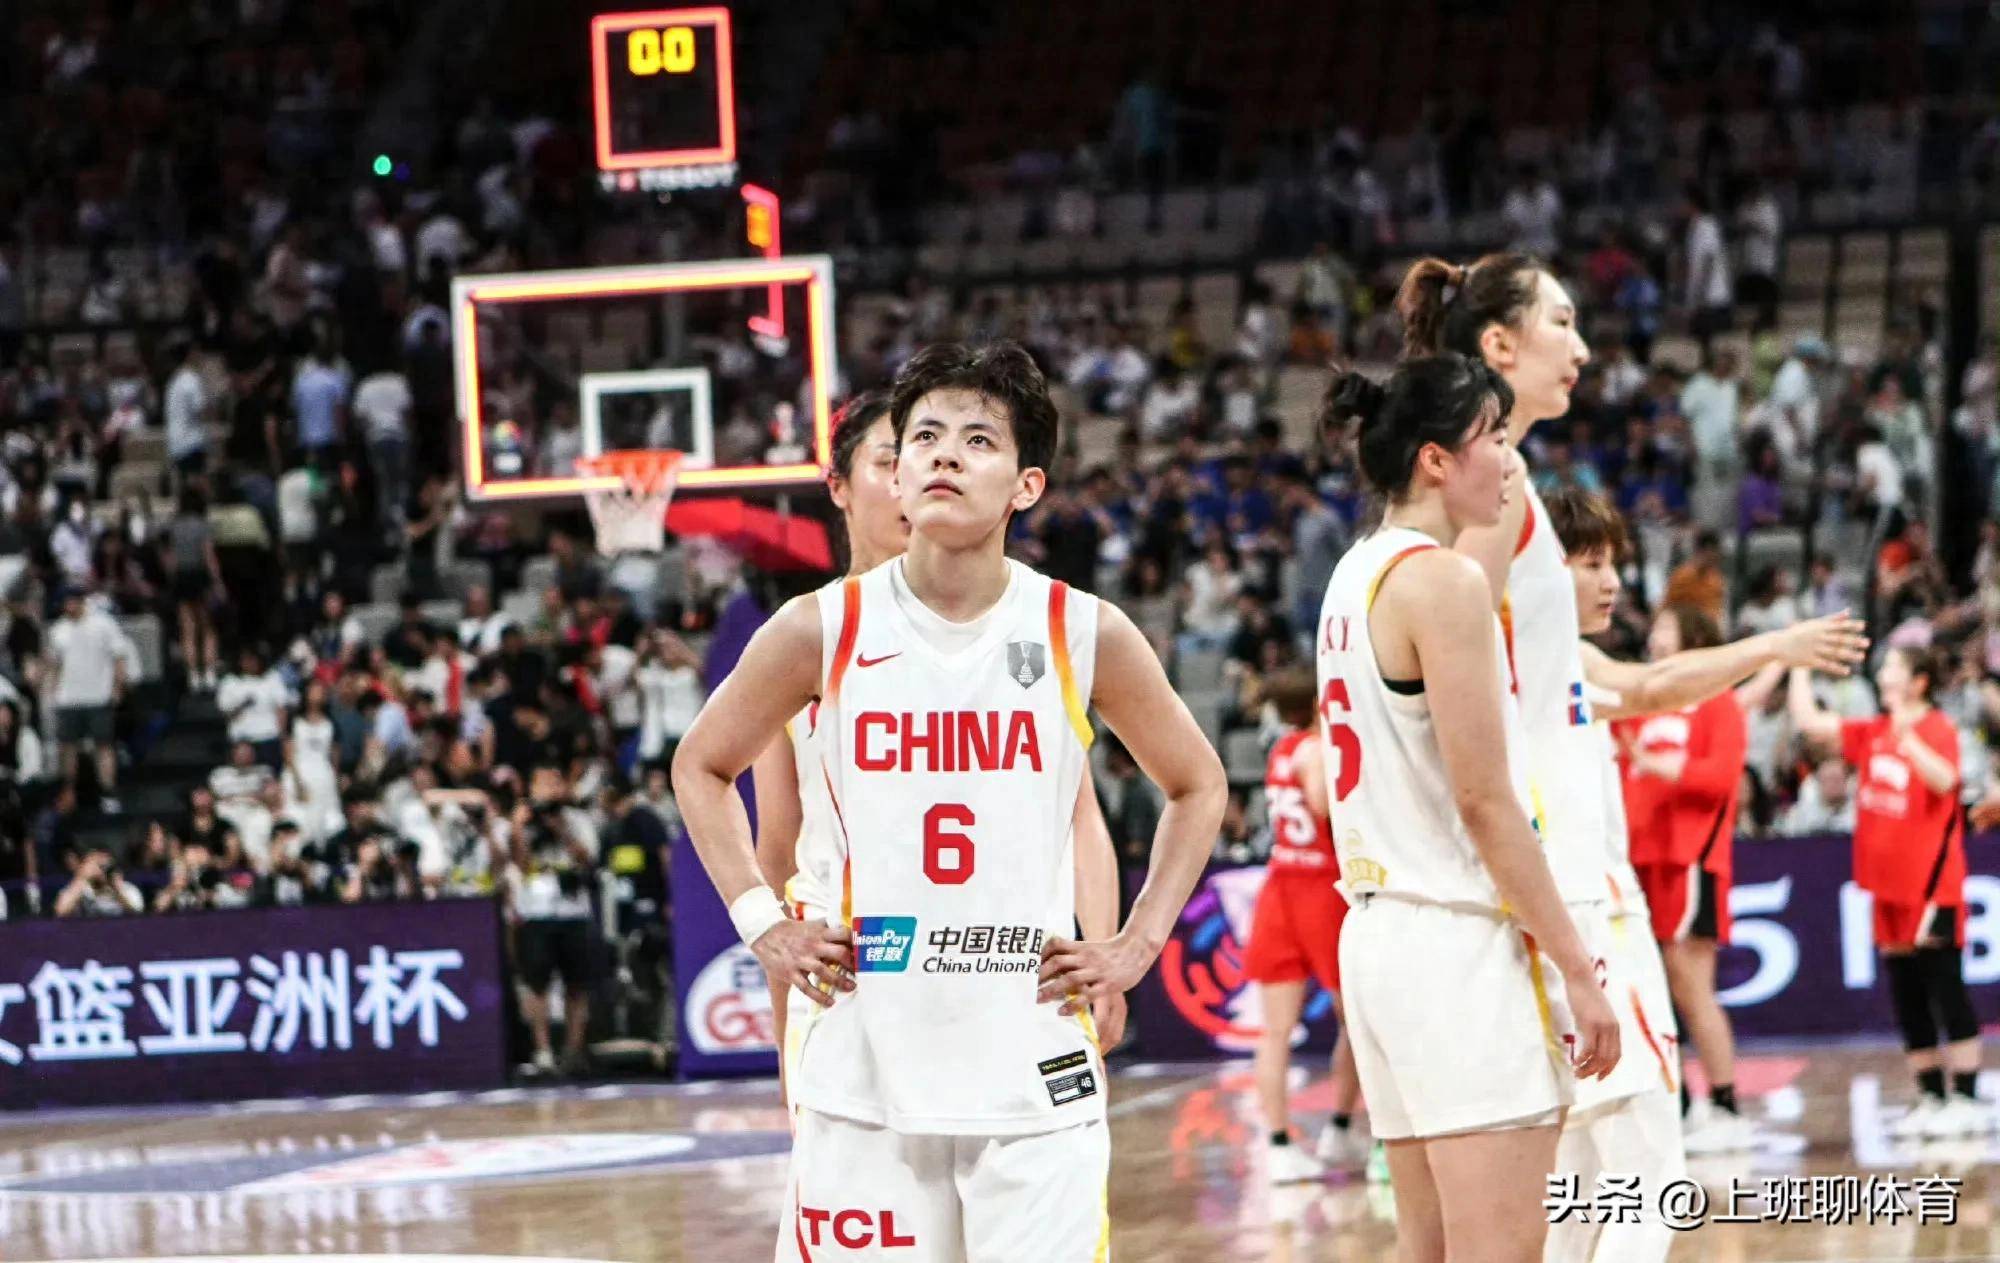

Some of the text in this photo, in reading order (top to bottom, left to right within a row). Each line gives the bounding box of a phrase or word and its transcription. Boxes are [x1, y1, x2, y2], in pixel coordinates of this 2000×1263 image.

[855, 711, 1042, 772] CHINA
[923, 803, 975, 884] 6
[923, 956, 1041, 974] China UnionPa
[0, 944, 469, 1066] 篮亚洲杯
[802, 1207, 916, 1249] TCL
